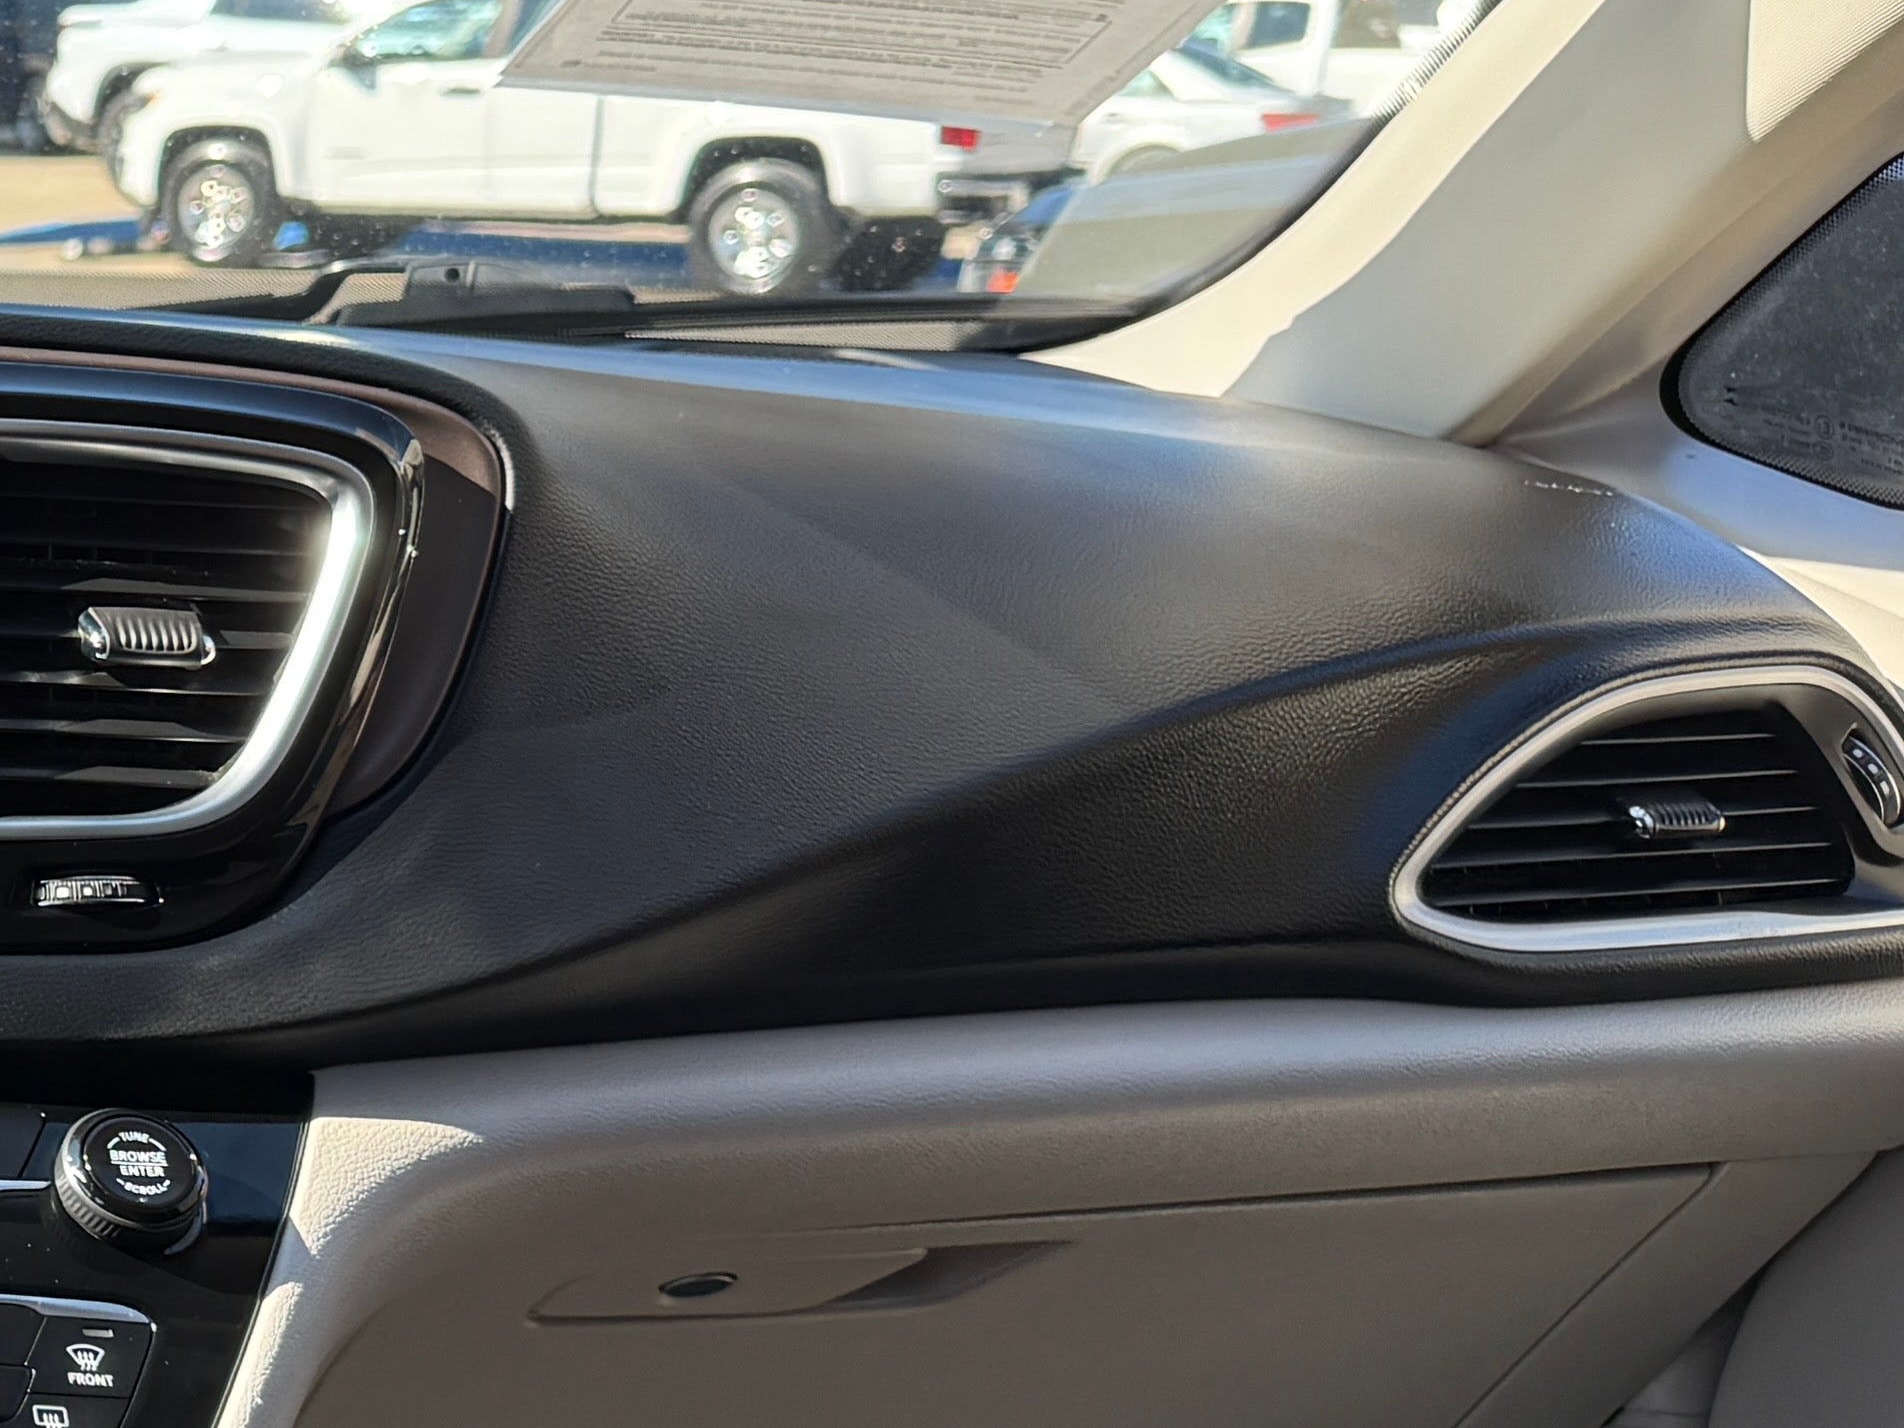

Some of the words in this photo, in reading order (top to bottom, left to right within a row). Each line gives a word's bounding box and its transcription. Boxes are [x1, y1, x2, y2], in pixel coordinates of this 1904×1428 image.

[118, 1131, 150, 1144] TUNE
[109, 1149, 167, 1163] BROWSE
[119, 1164, 166, 1177] ENTER
[124, 1181, 168, 1195] SCROLL
[67, 1372, 114, 1389] FRONT
